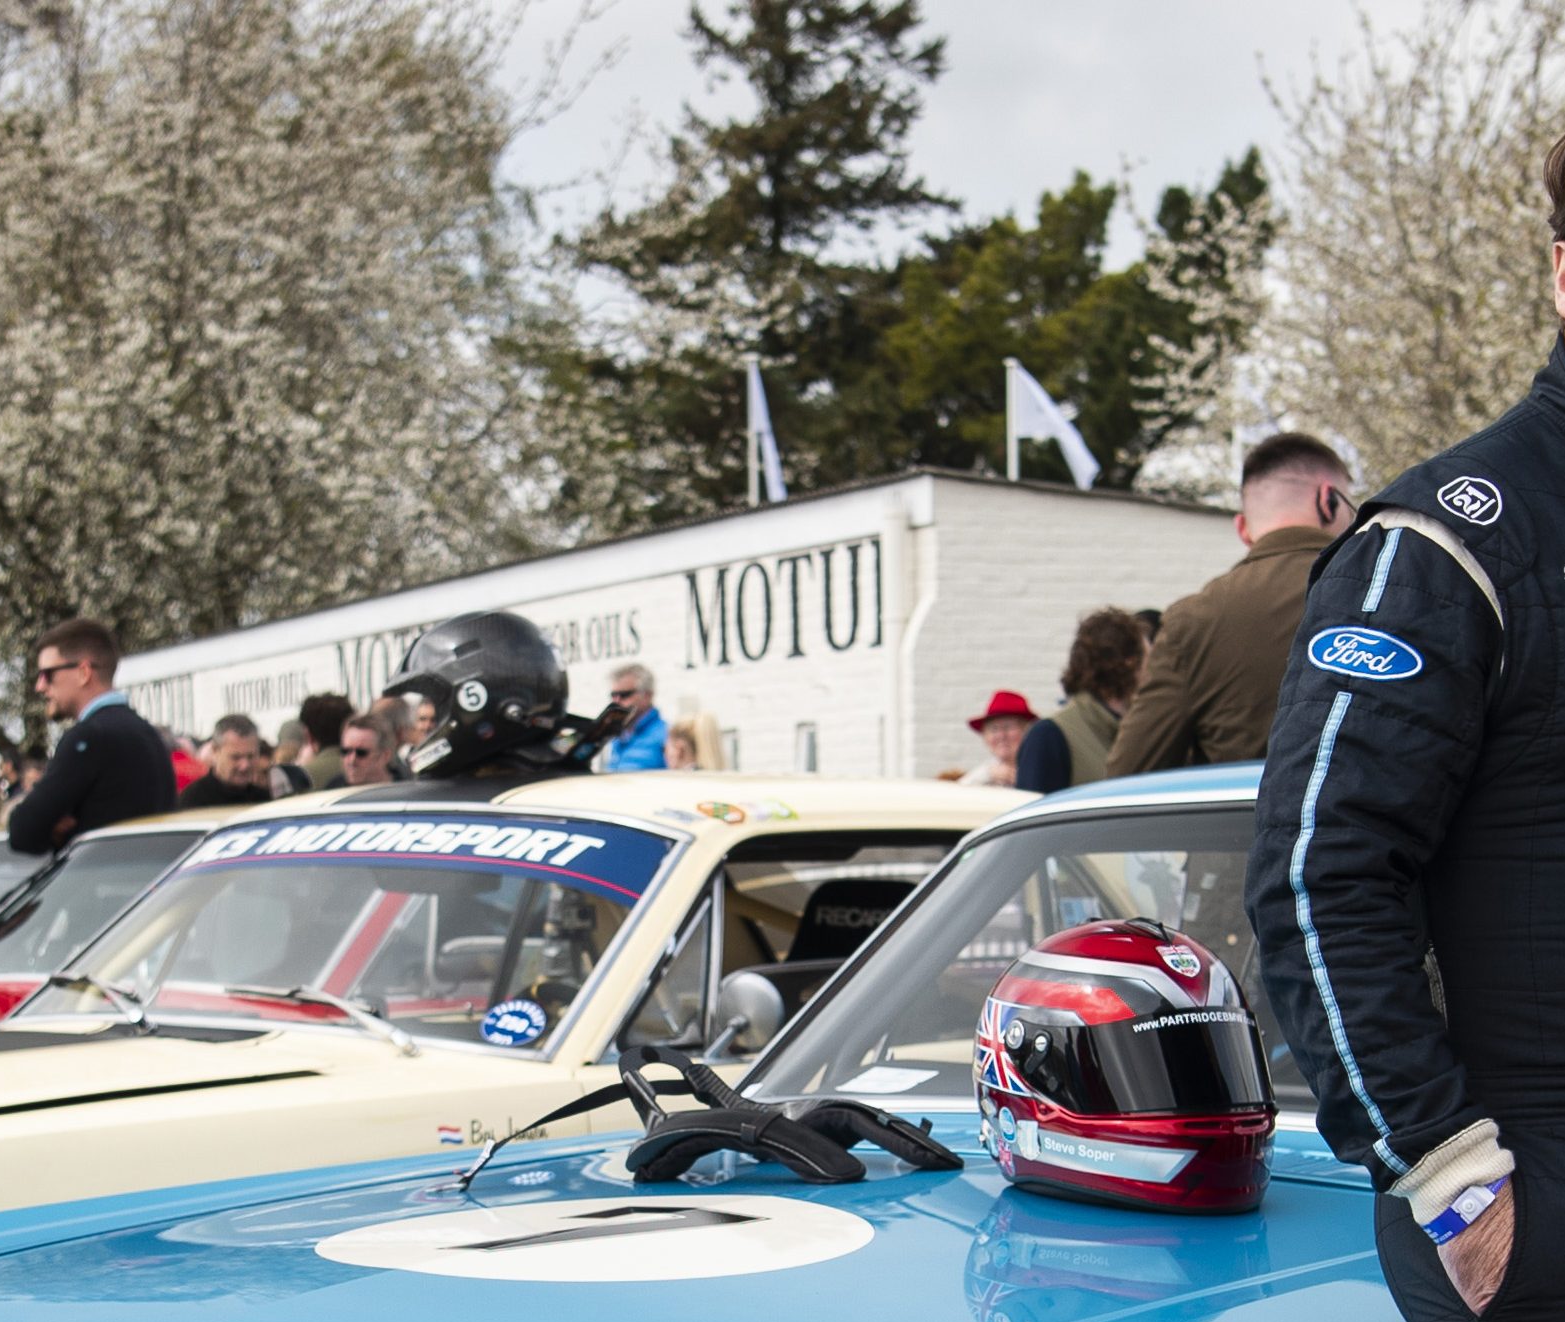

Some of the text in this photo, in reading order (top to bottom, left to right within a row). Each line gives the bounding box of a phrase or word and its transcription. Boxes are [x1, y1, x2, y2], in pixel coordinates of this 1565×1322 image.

[1322, 633, 1397, 673] Ford
[465, 686, 481, 707] 5
[259, 822, 605, 866] MOTORSPORT
[815, 906, 893, 929] RECAR
[1044, 1137, 1116, 1162] Steve Soper
